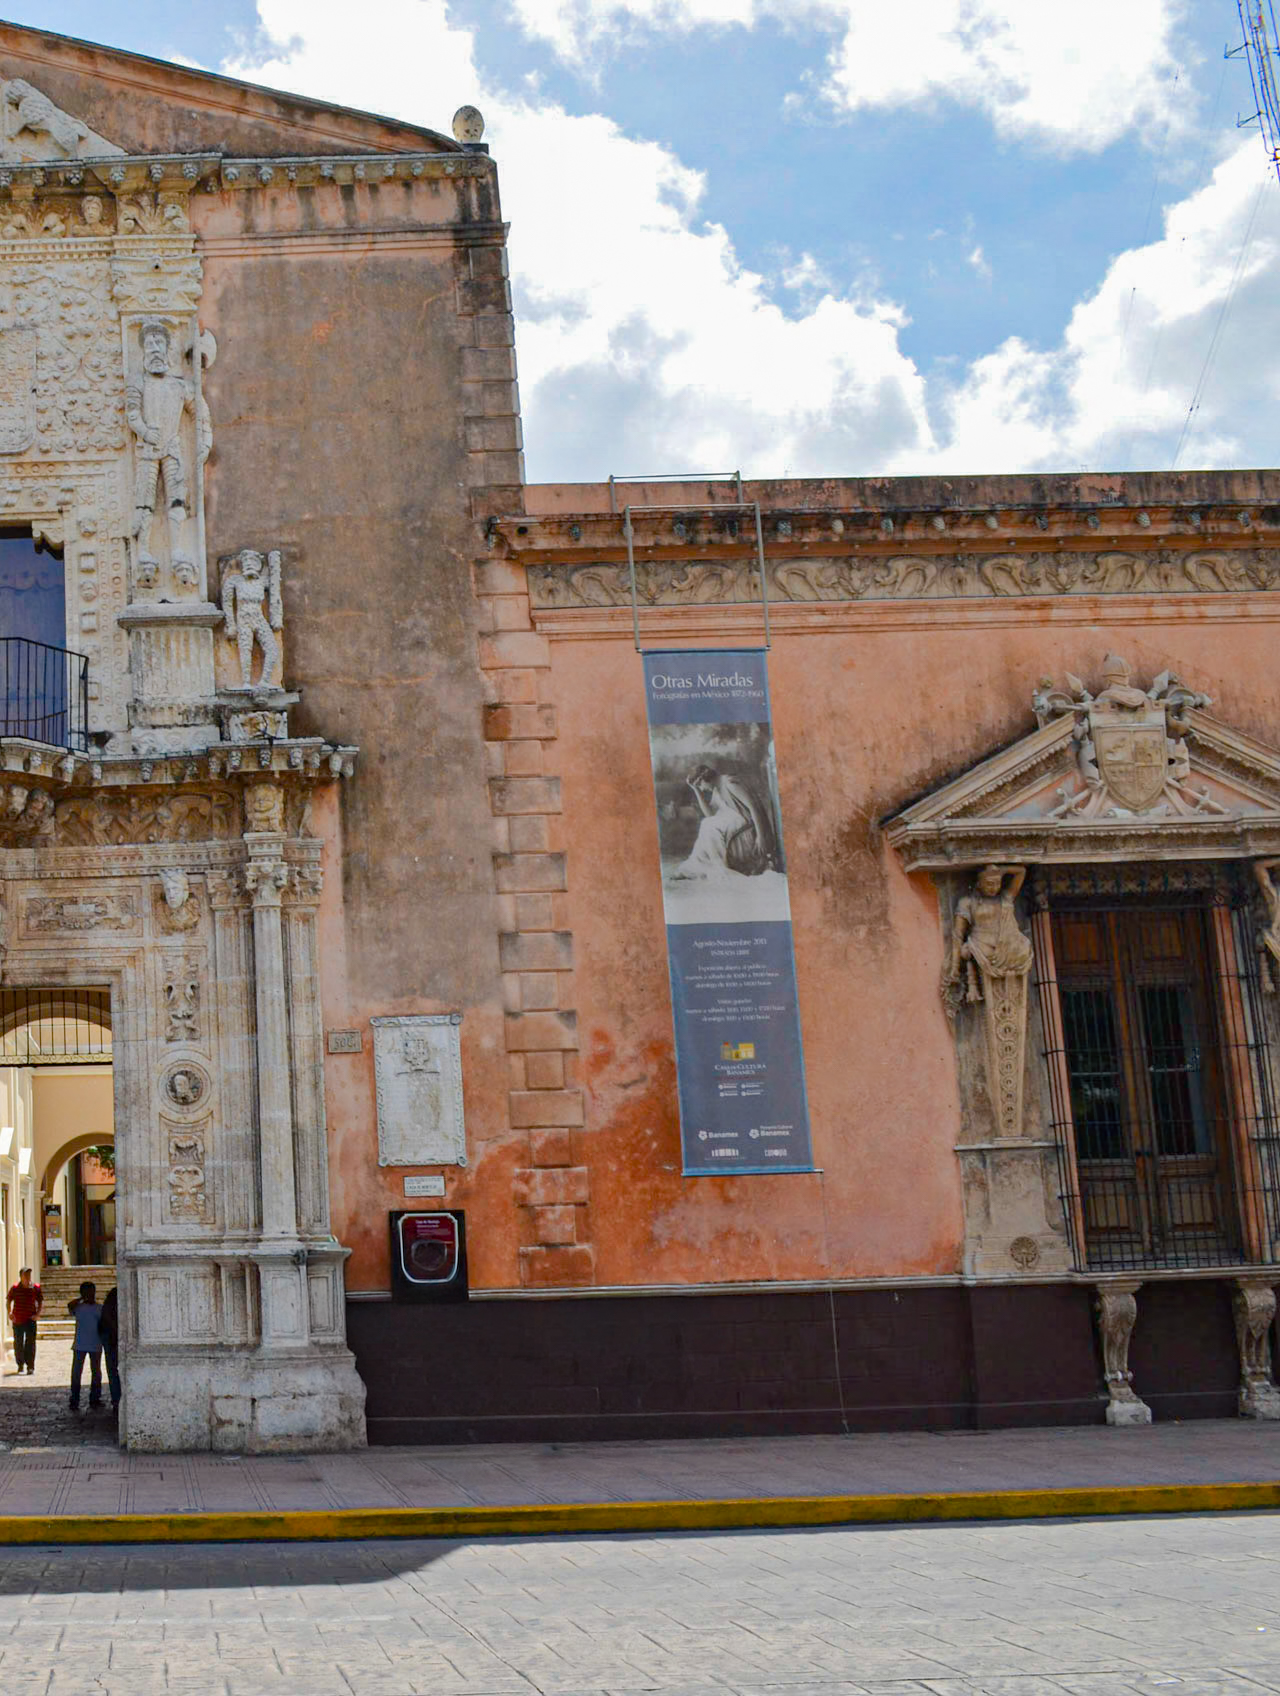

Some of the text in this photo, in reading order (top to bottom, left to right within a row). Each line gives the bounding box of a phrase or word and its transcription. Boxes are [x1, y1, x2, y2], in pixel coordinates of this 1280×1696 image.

[652, 671, 753, 689] Otras Miradas
[708, 1131, 739, 1139] Banamex
